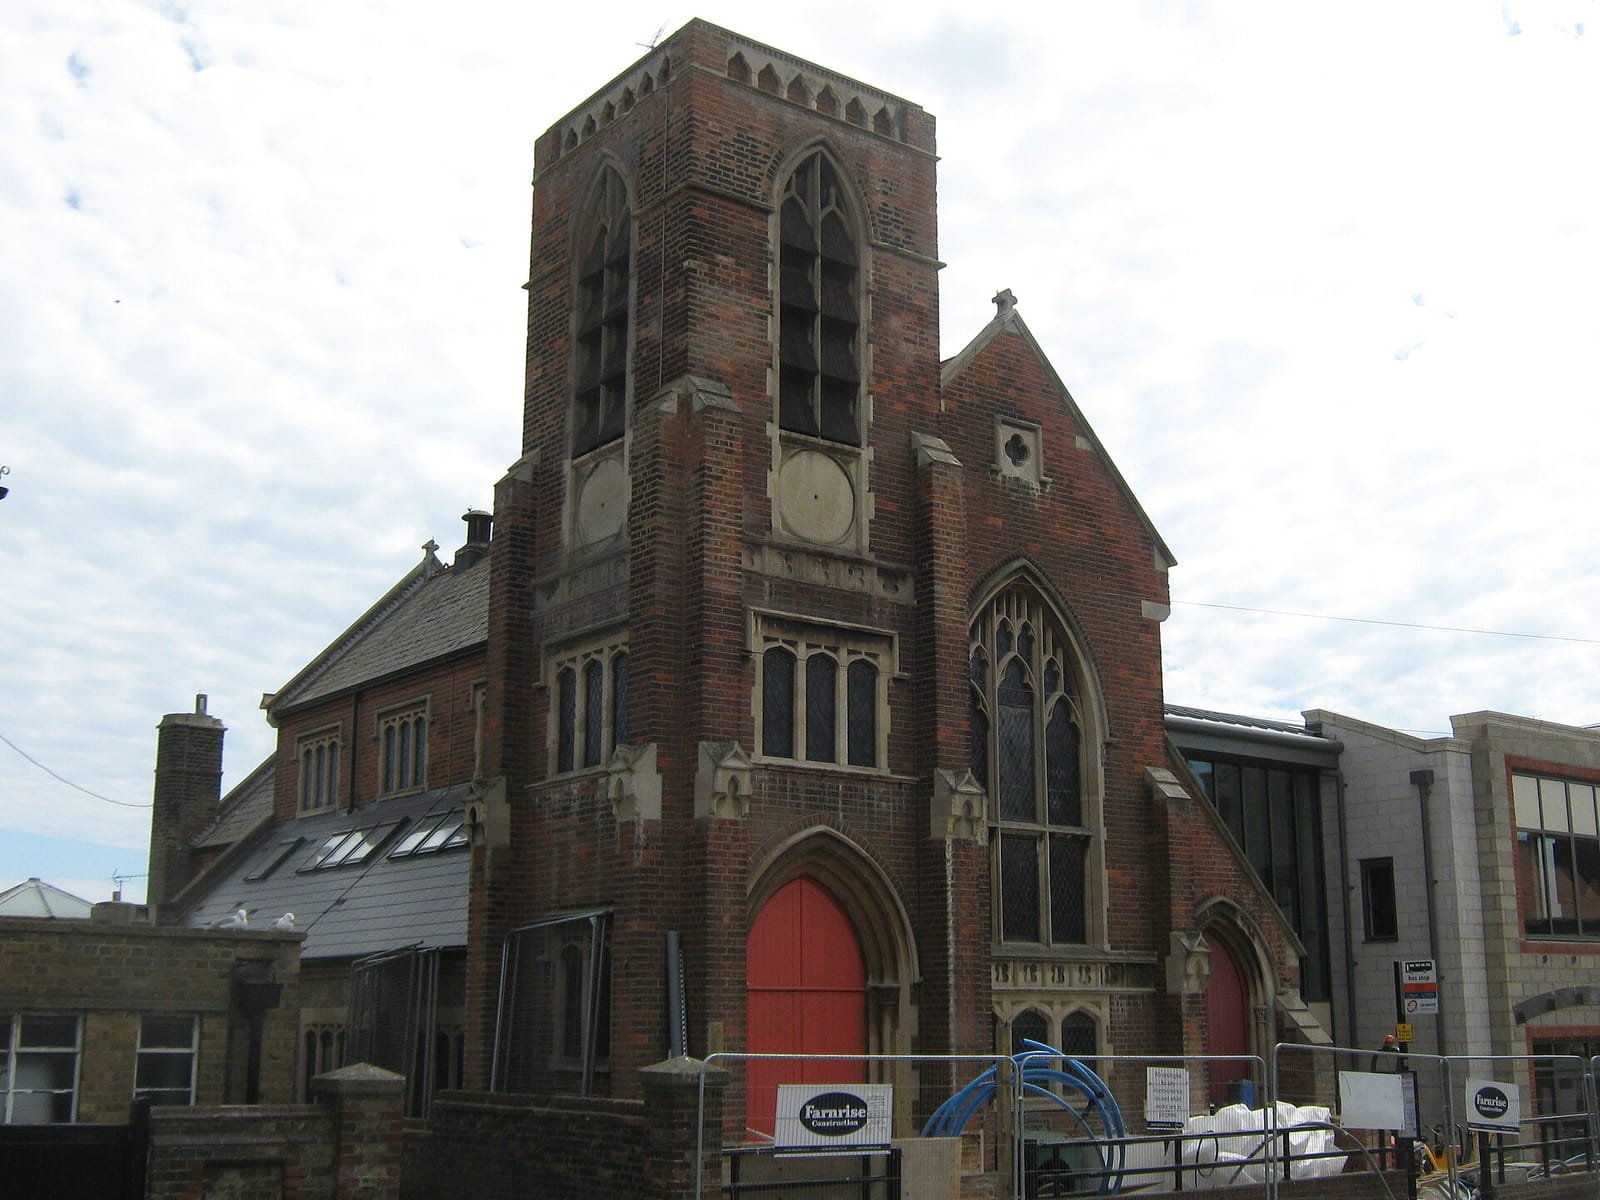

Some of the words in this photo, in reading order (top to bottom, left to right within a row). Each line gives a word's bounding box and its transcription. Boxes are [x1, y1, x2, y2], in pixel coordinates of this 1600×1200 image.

[1477, 1094, 1507, 1108] Farnrise
[805, 1105, 867, 1119] Farnrise
[811, 1119, 859, 1128] Construction
